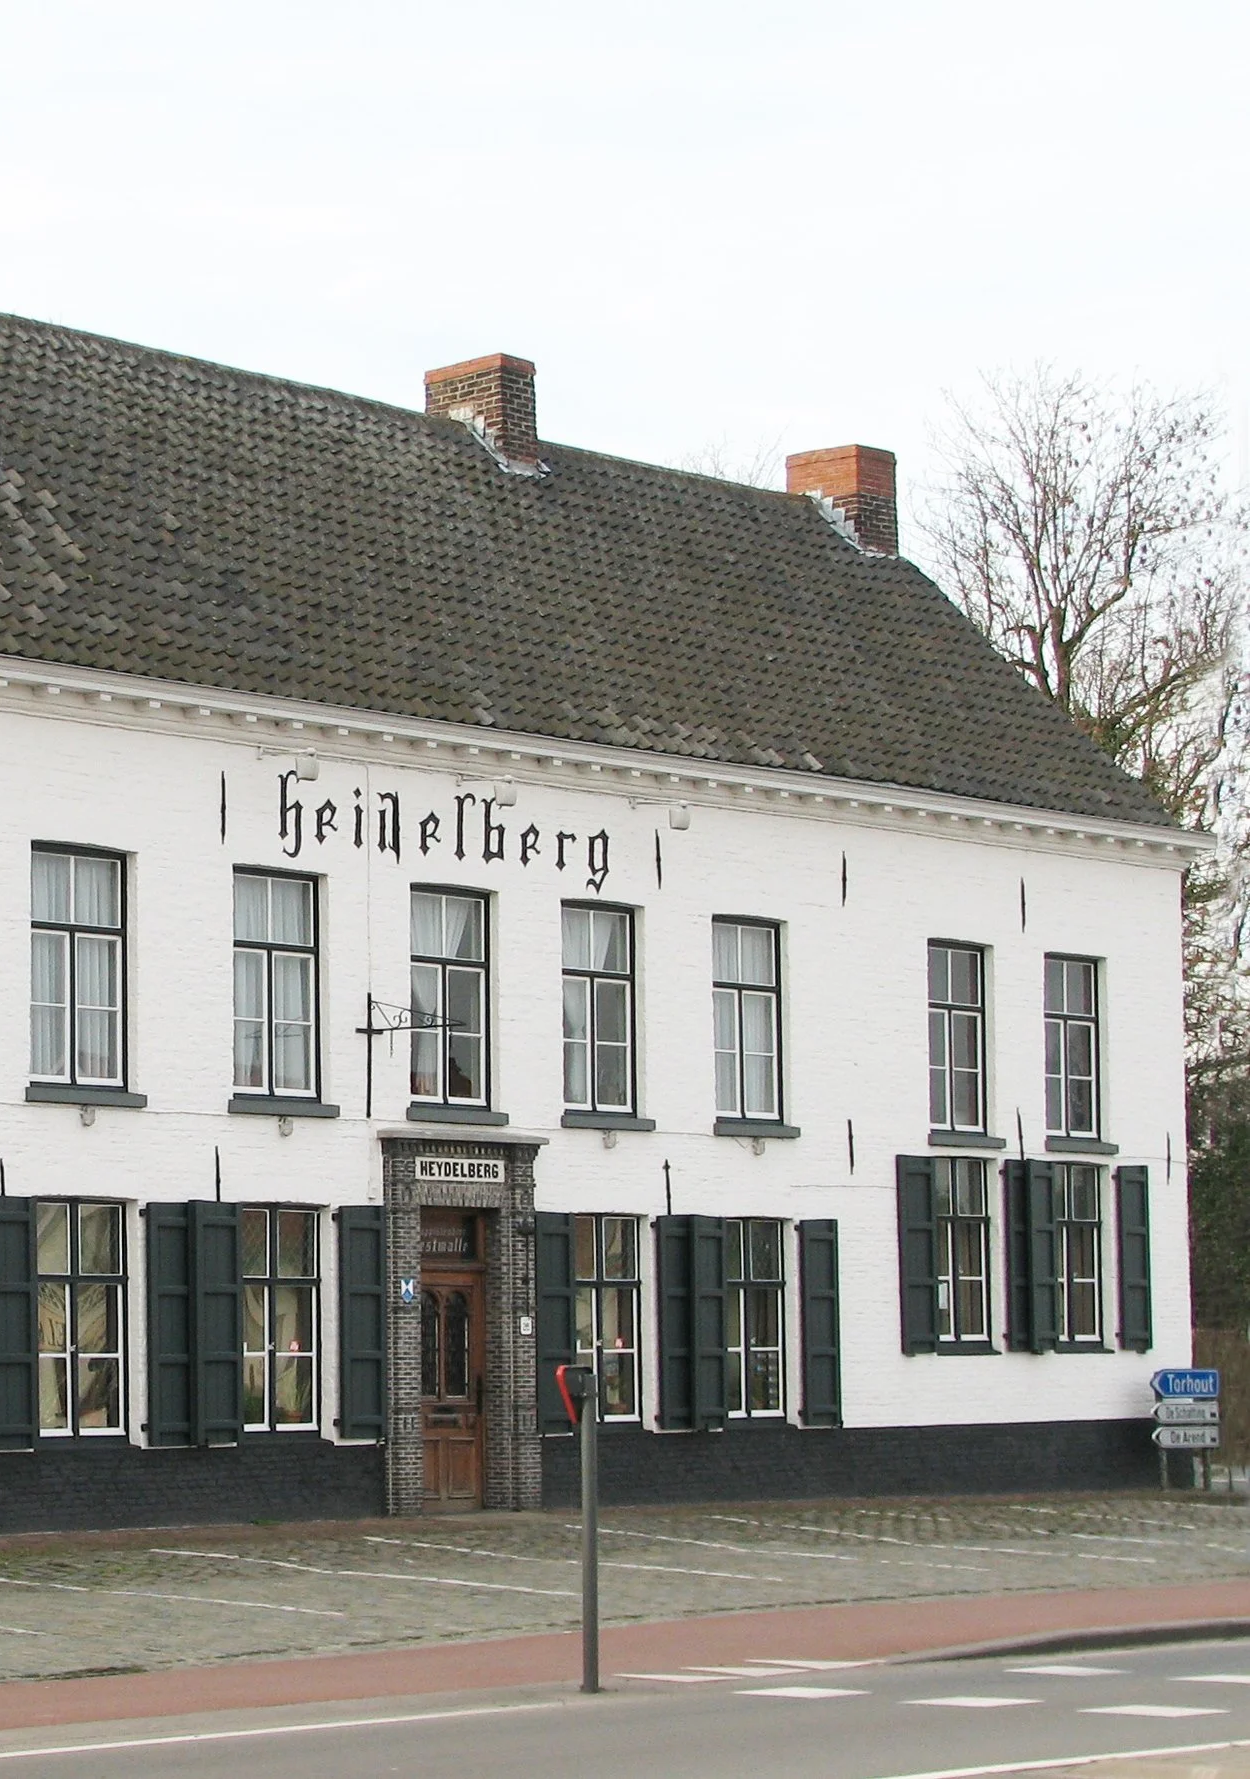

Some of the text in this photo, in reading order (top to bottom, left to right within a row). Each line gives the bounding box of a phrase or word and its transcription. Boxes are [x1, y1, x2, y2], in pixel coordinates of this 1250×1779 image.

[420, 1161, 499, 1179] HEYDELBERG
[419, 1237, 468, 1253] estmalle
[1167, 1373, 1214, 1393] Torhout
